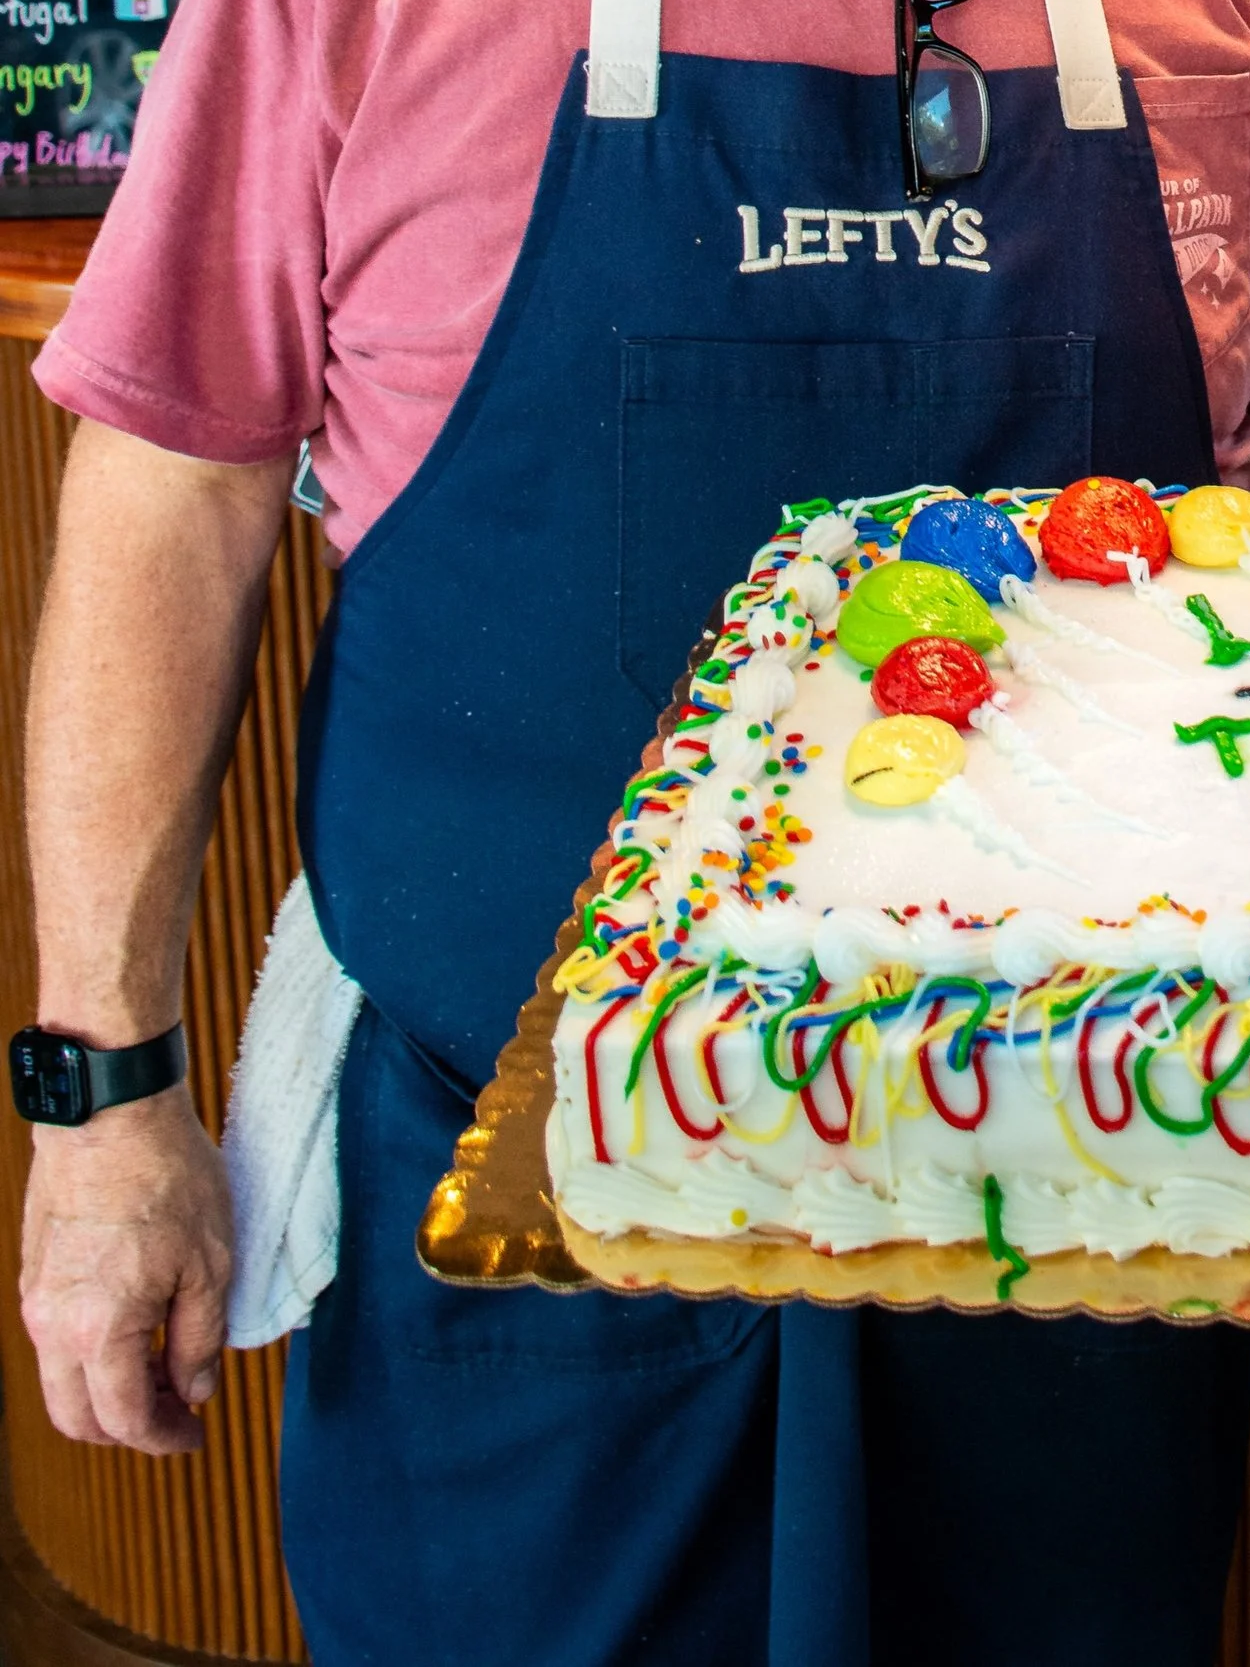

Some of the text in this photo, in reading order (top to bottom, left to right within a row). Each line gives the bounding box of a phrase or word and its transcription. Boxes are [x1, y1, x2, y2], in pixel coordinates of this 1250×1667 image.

[1183, 178, 1200, 194] OF
[738, 198, 991, 273] LEFTY'S
[1163, 193, 1232, 236] LPARK
